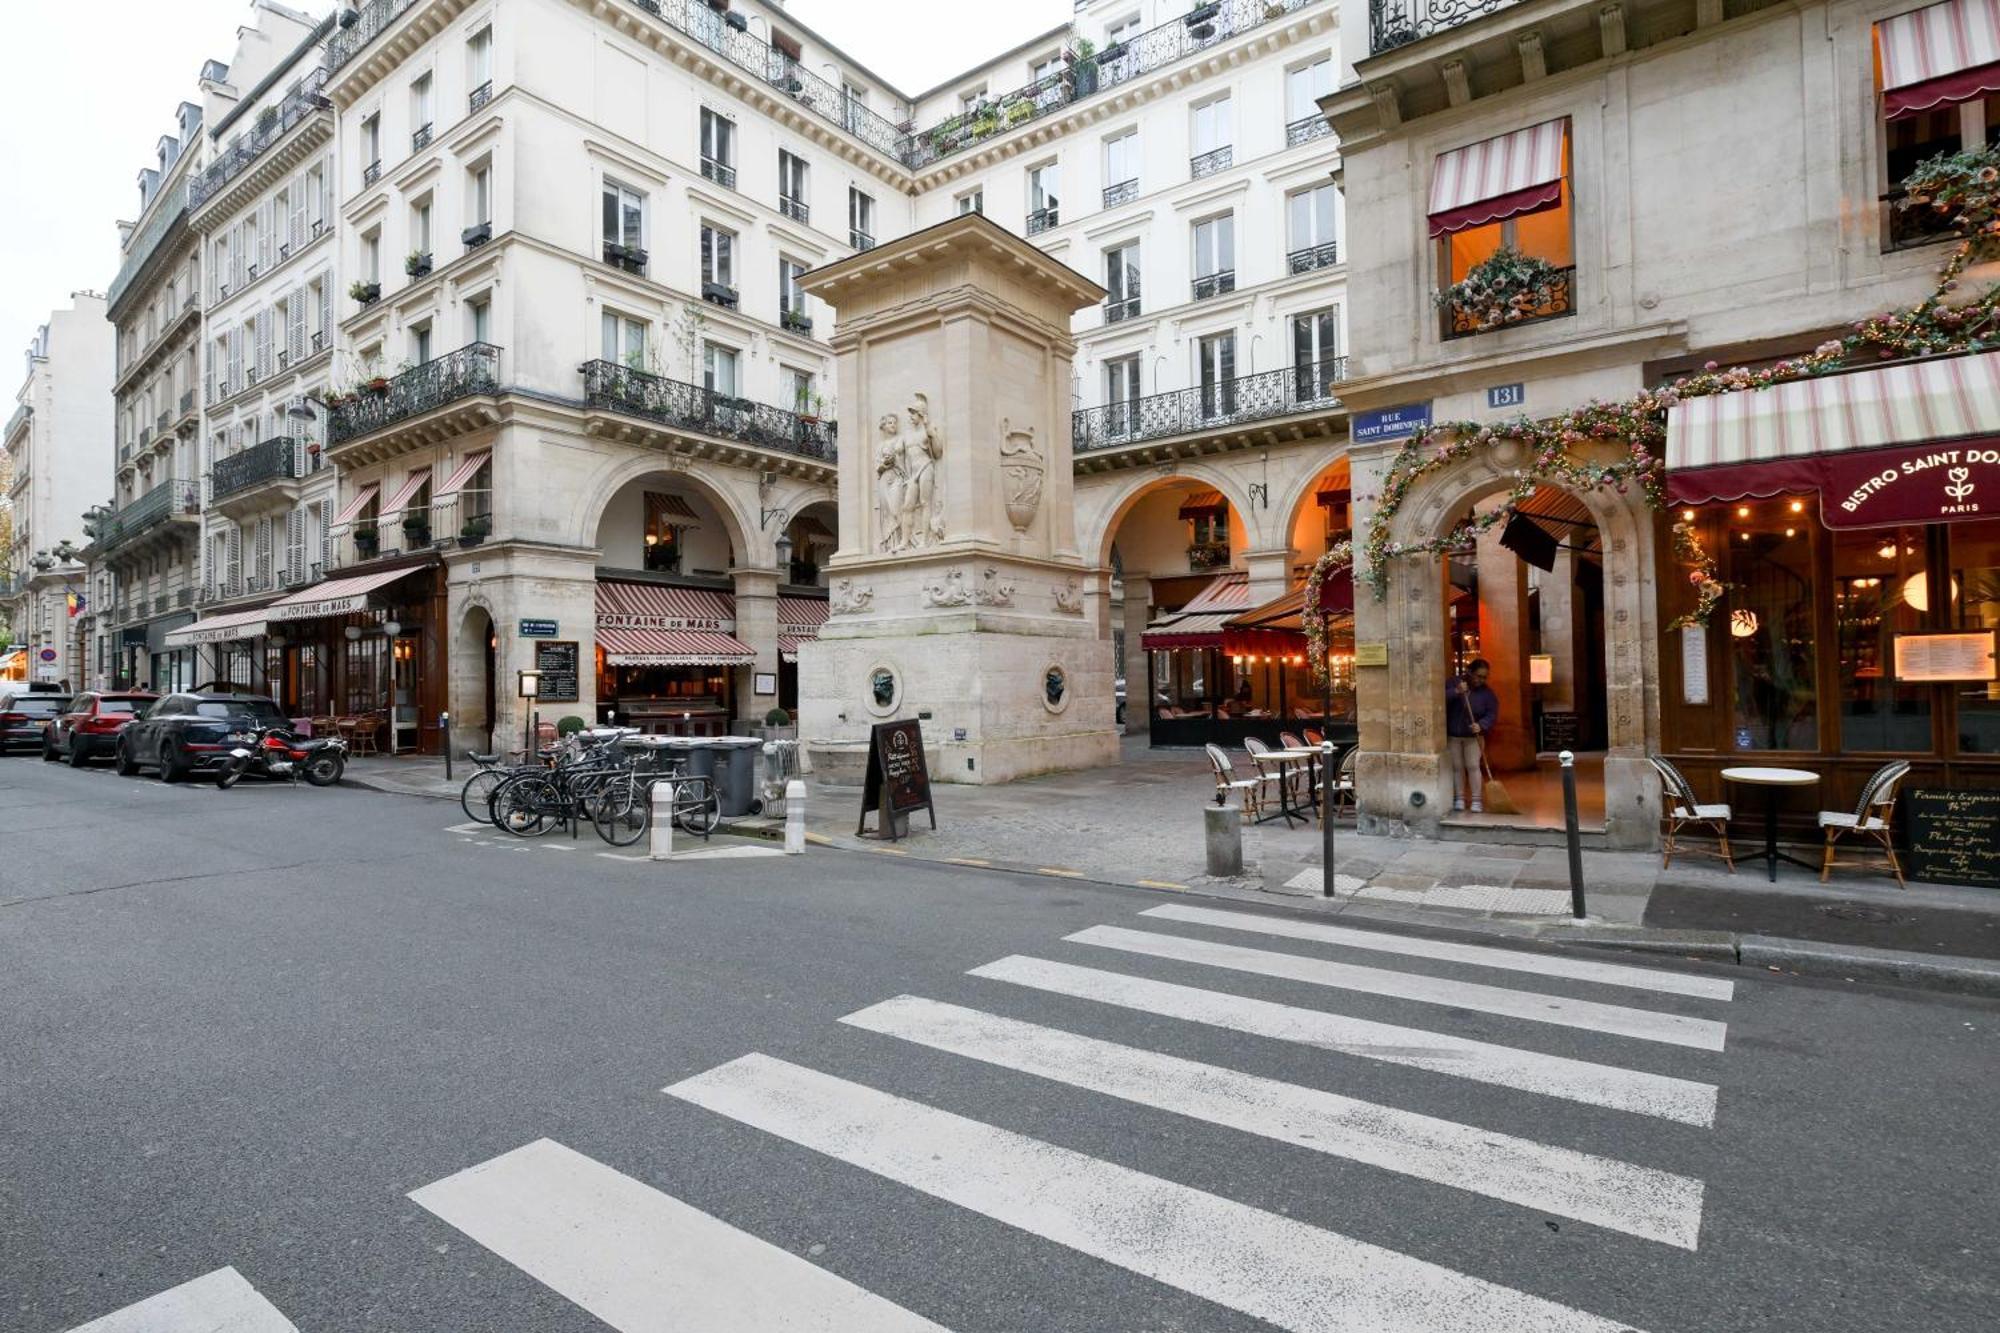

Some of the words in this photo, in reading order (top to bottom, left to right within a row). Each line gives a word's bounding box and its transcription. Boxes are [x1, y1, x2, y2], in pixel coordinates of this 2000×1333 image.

[1493, 386, 1519, 405] 131
[1381, 412, 1401, 423] RUE
[1356, 426, 1381, 437] SAINT
[1841, 469, 1898, 512] BISTRO
[1902, 450, 1960, 474] SAINT
[1966, 450, 2000, 465] DO
[1941, 503, 1979, 514] PARIS
[596, 615, 666, 627] FONTAINE
[670, 620, 682, 628] DE
[686, 619, 720, 629] MARS
